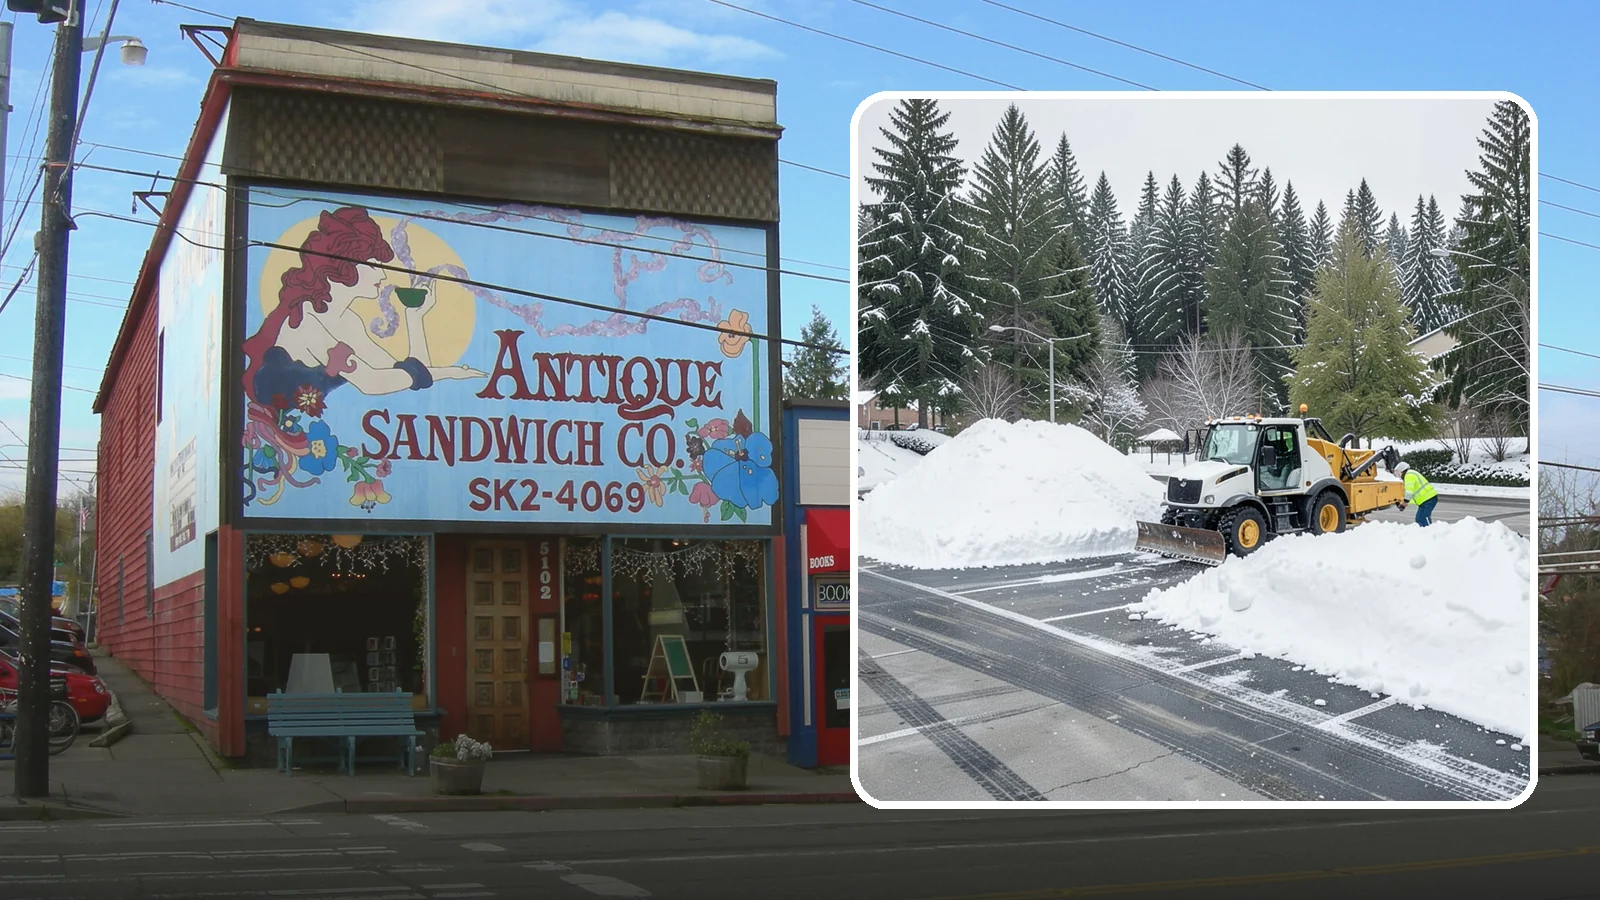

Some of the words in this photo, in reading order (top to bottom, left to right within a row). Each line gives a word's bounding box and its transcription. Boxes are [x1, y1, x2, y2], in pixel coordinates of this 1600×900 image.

[475, 329, 724, 420] ANTIQUE
[361, 408, 604, 467] SANDWICH
[617, 422, 685, 468] CO.
[468, 477, 646, 512] SK2-4069
[540, 541, 551, 600] 5102
[810, 555, 835, 569] BOOKS
